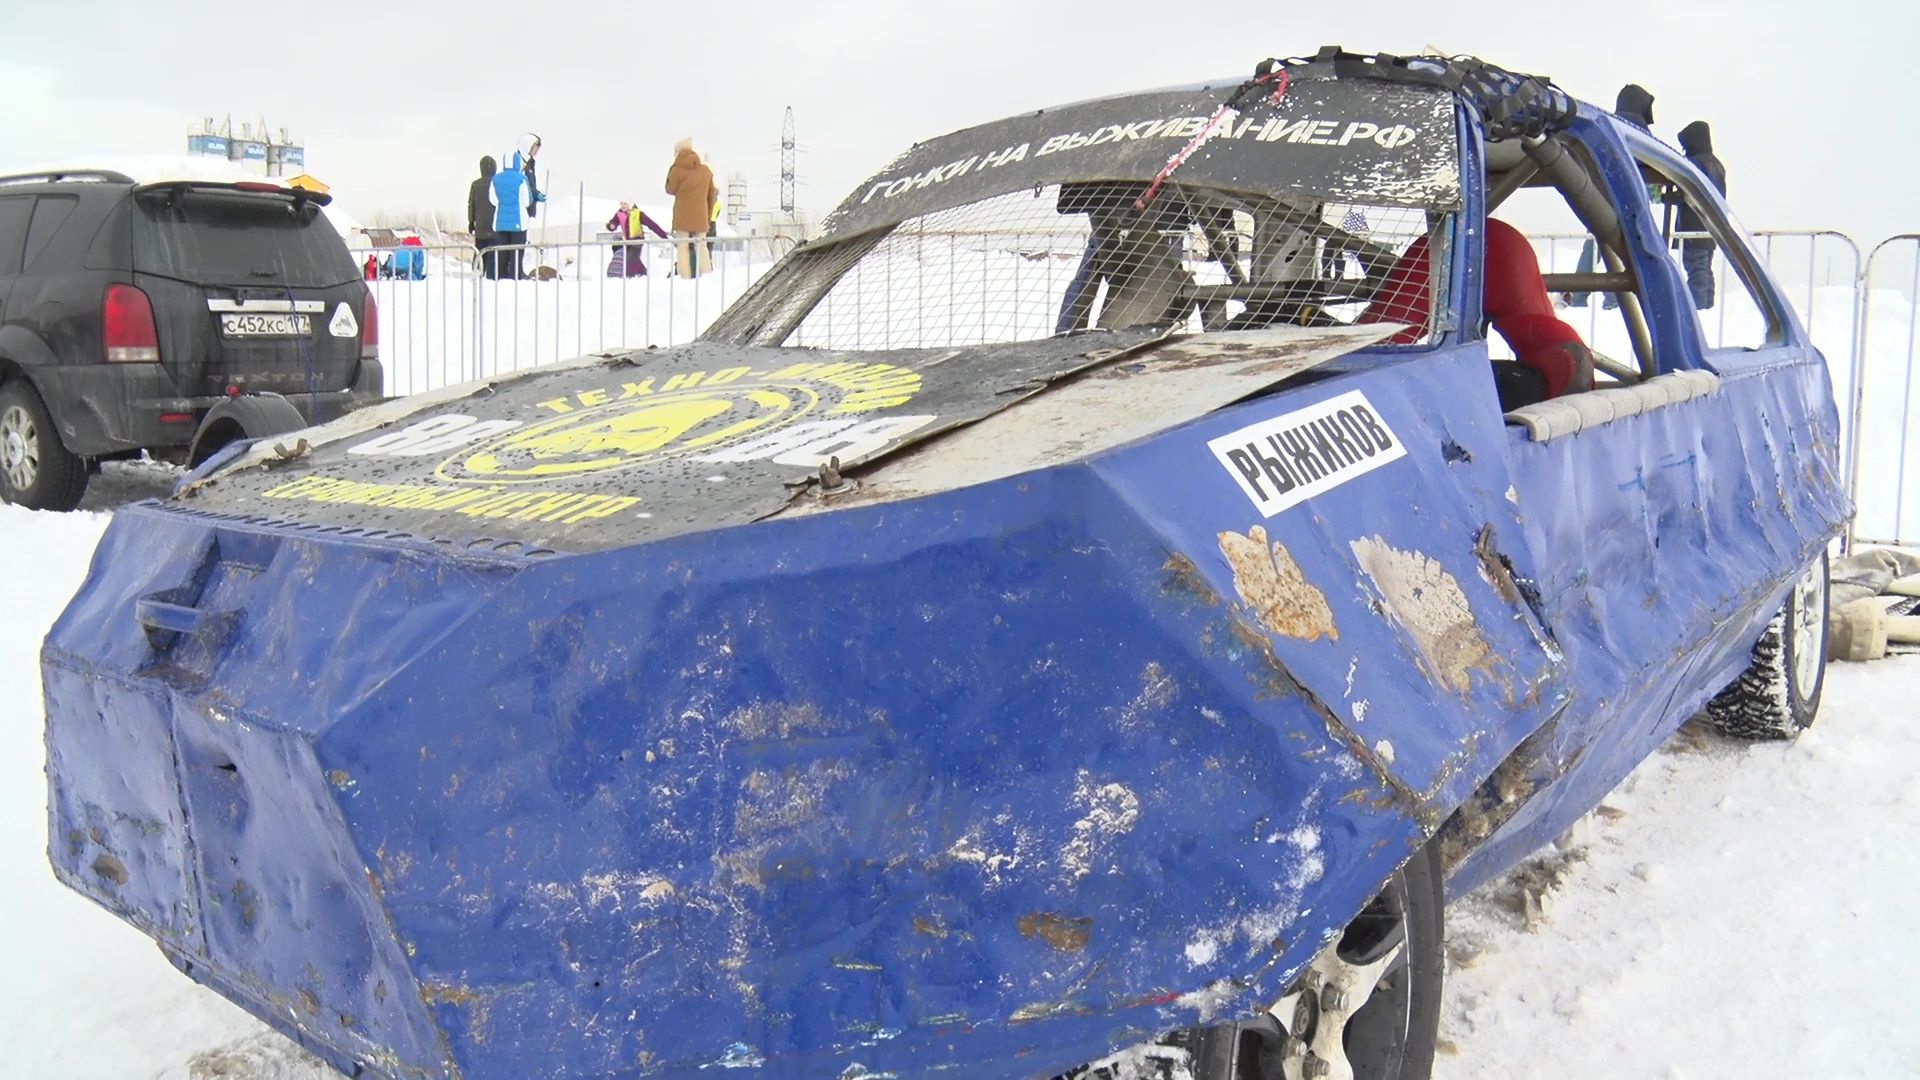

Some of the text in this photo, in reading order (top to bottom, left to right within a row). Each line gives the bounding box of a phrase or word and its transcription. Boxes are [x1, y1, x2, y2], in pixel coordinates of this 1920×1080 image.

[861, 114, 1416, 204] ГОНКИ НА ВЫЖИВАНИЕ.РФ
[347, 413, 523, 456] 88
[686, 414, 938, 467] 88
[1225, 404, 1393, 502] РЫЖИКОВ
[455, 491, 642, 524] ЦЕНТР
